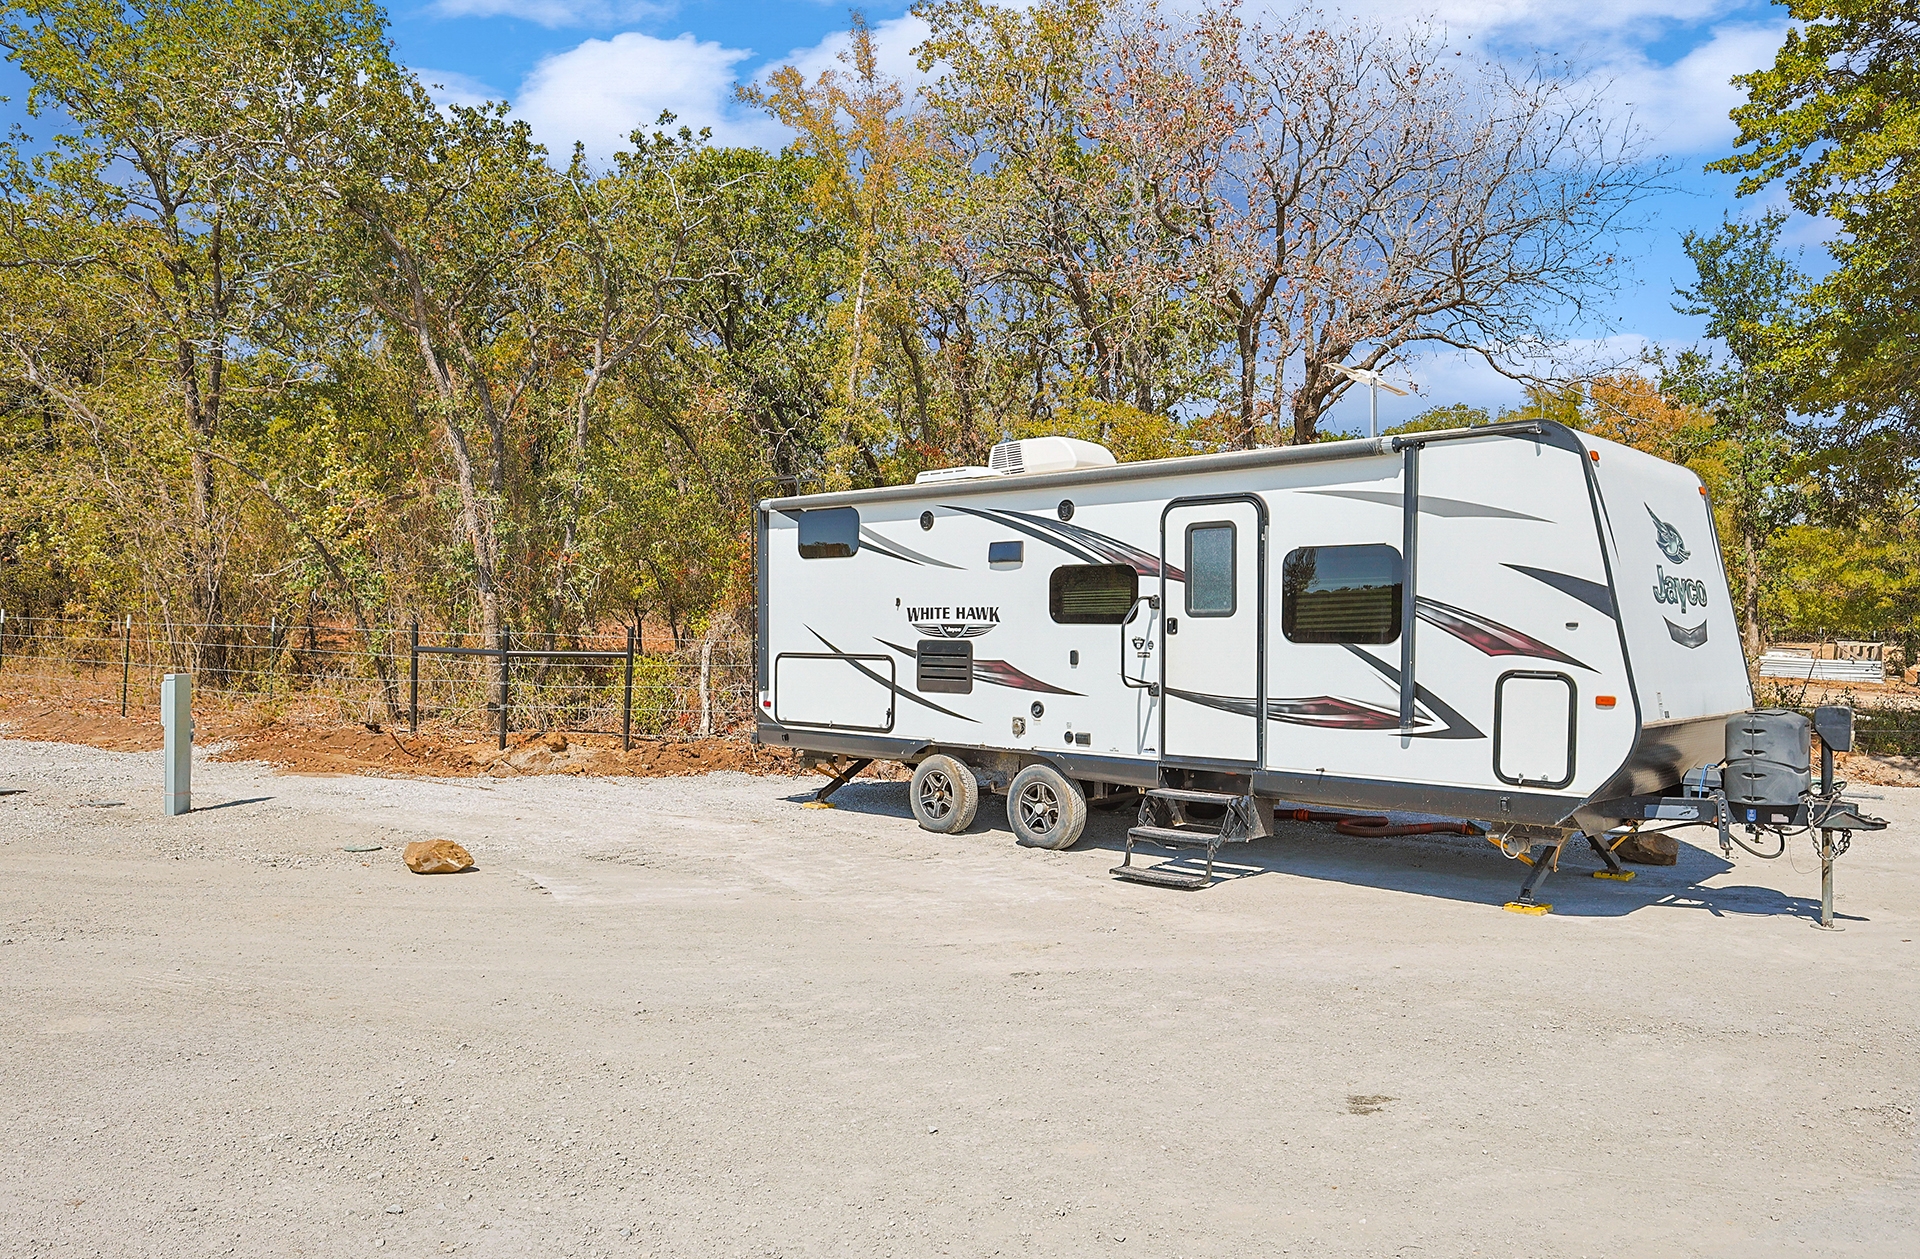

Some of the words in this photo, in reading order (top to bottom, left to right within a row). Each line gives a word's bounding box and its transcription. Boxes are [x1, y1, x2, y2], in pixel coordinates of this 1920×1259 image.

[1652, 564, 1708, 614] Jayco
[906, 606, 950, 622] WHITE
[956, 606, 1001, 623] HAWK
